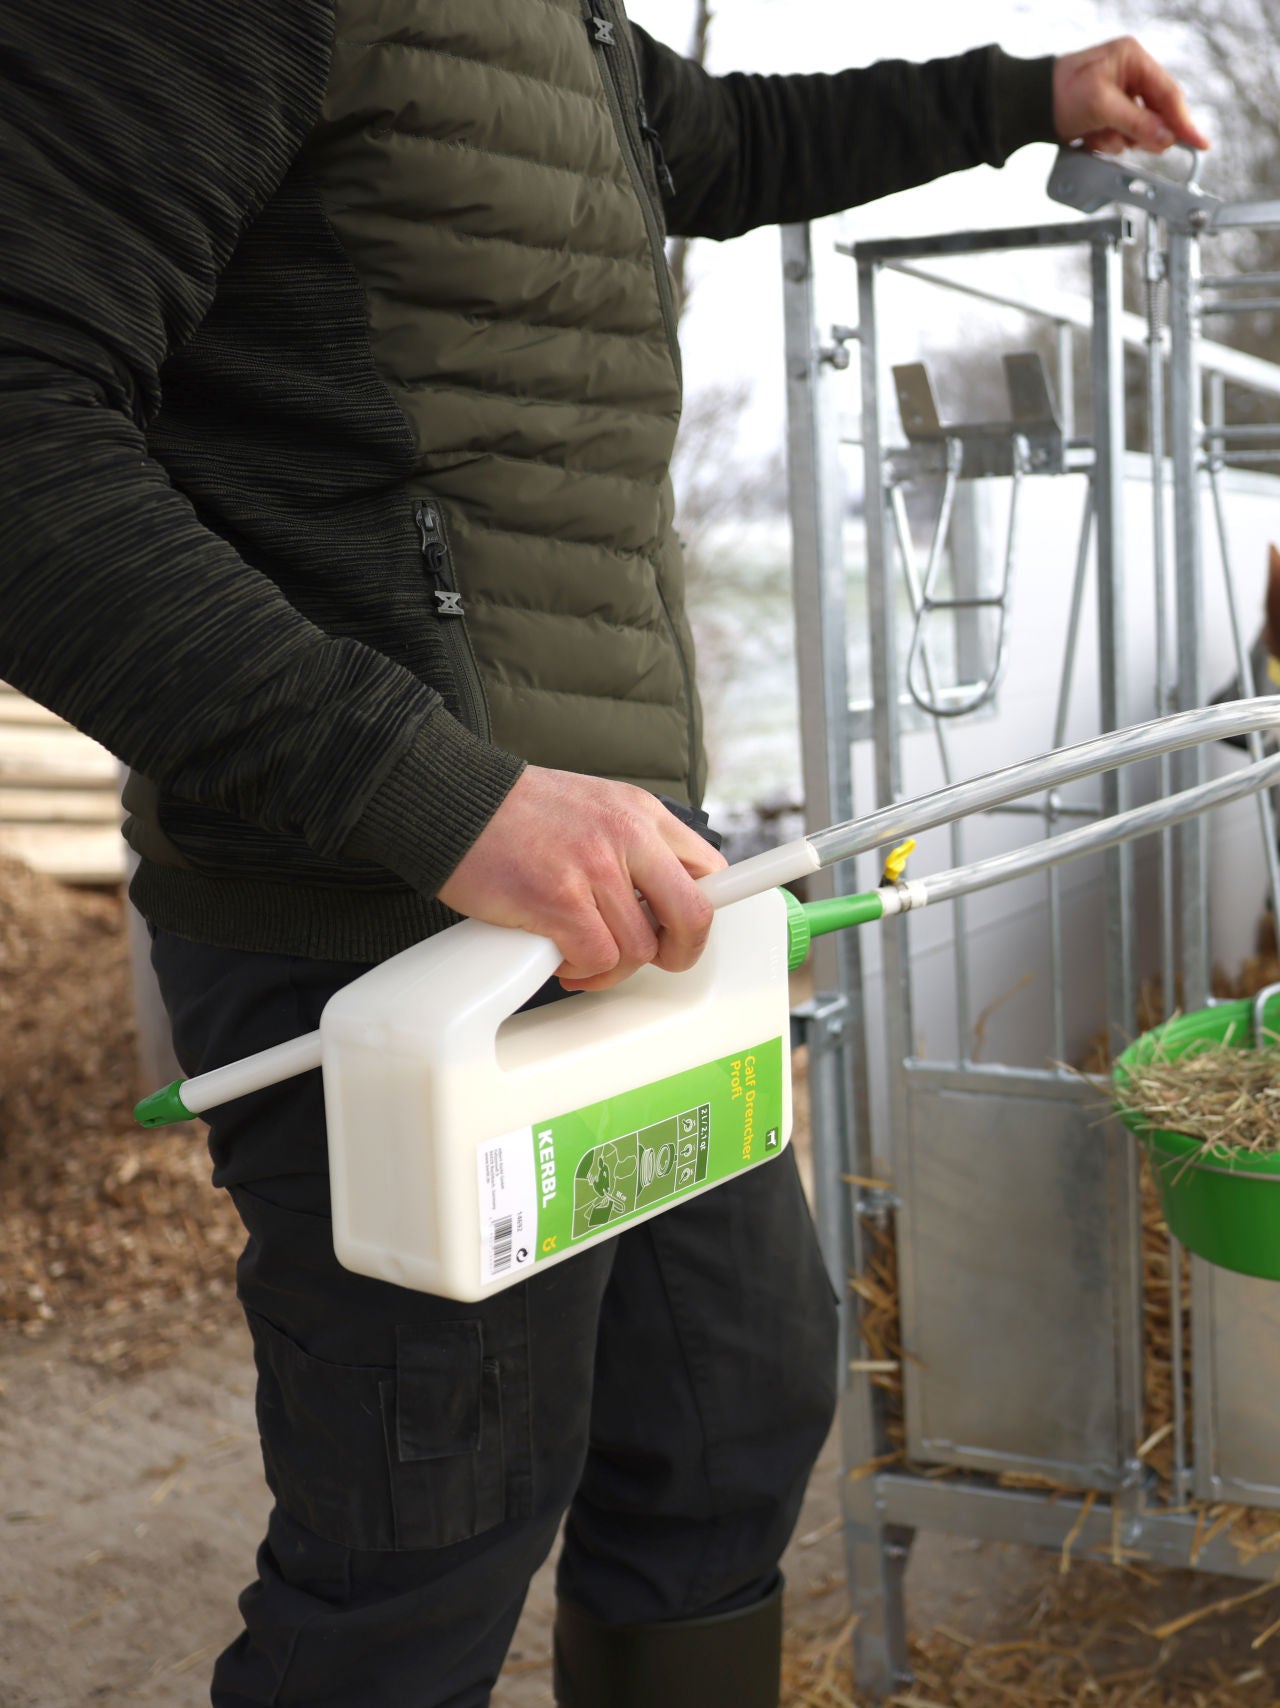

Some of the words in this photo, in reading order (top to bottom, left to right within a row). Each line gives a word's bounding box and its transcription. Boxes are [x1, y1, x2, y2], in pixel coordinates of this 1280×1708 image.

[730, 1060, 742, 1100] Profi
[744, 1055, 756, 1087] Calf
[742, 1090, 756, 1160] Drencher
[537, 1129, 557, 1209] KERBL
